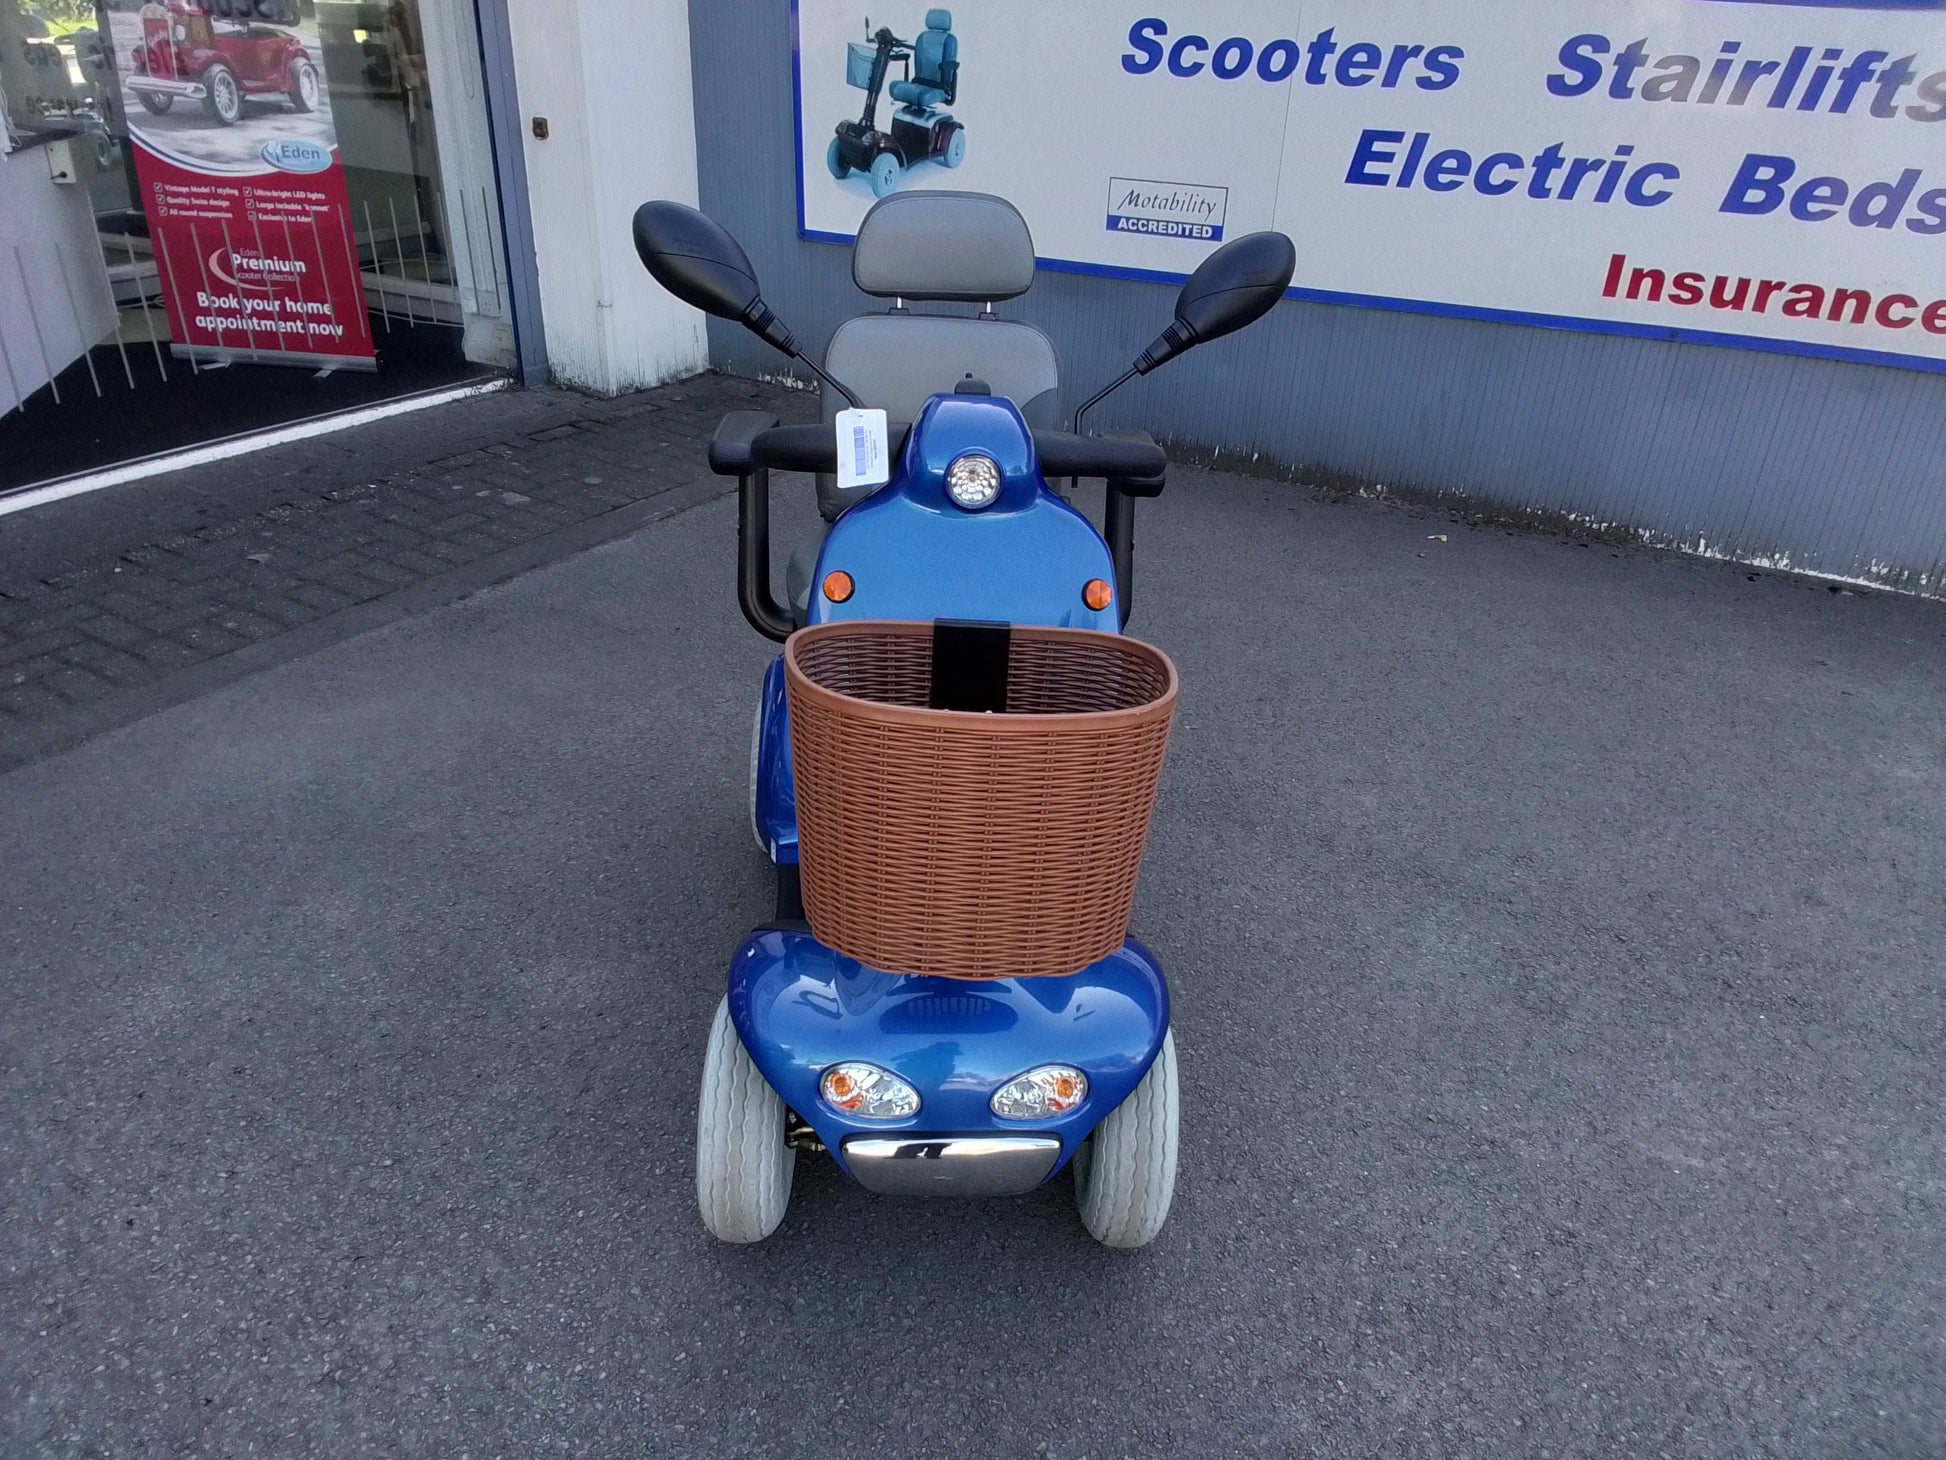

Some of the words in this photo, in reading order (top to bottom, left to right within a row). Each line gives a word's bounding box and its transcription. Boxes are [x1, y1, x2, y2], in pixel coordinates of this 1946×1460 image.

[1121, 17, 1465, 91] Scooters
[1546, 33, 1946, 123] Stairlifts
[281, 144, 321, 160] Eden
[1344, 128, 1681, 207] Electric
[1718, 153, 1946, 235] Beds
[292, 190, 306, 198] LED
[1116, 188, 1217, 222] Motability
[1117, 217, 1213, 238] ACCREDITED
[232, 253, 307, 273] Premium
[237, 272, 262, 280] cooter
[197, 291, 240, 310] Book
[243, 297, 281, 314] your
[284, 296, 333, 316] home
[1602, 253, 1946, 335] Insurance
[195, 313, 305, 335] appointment
[309, 322, 344, 337] now
